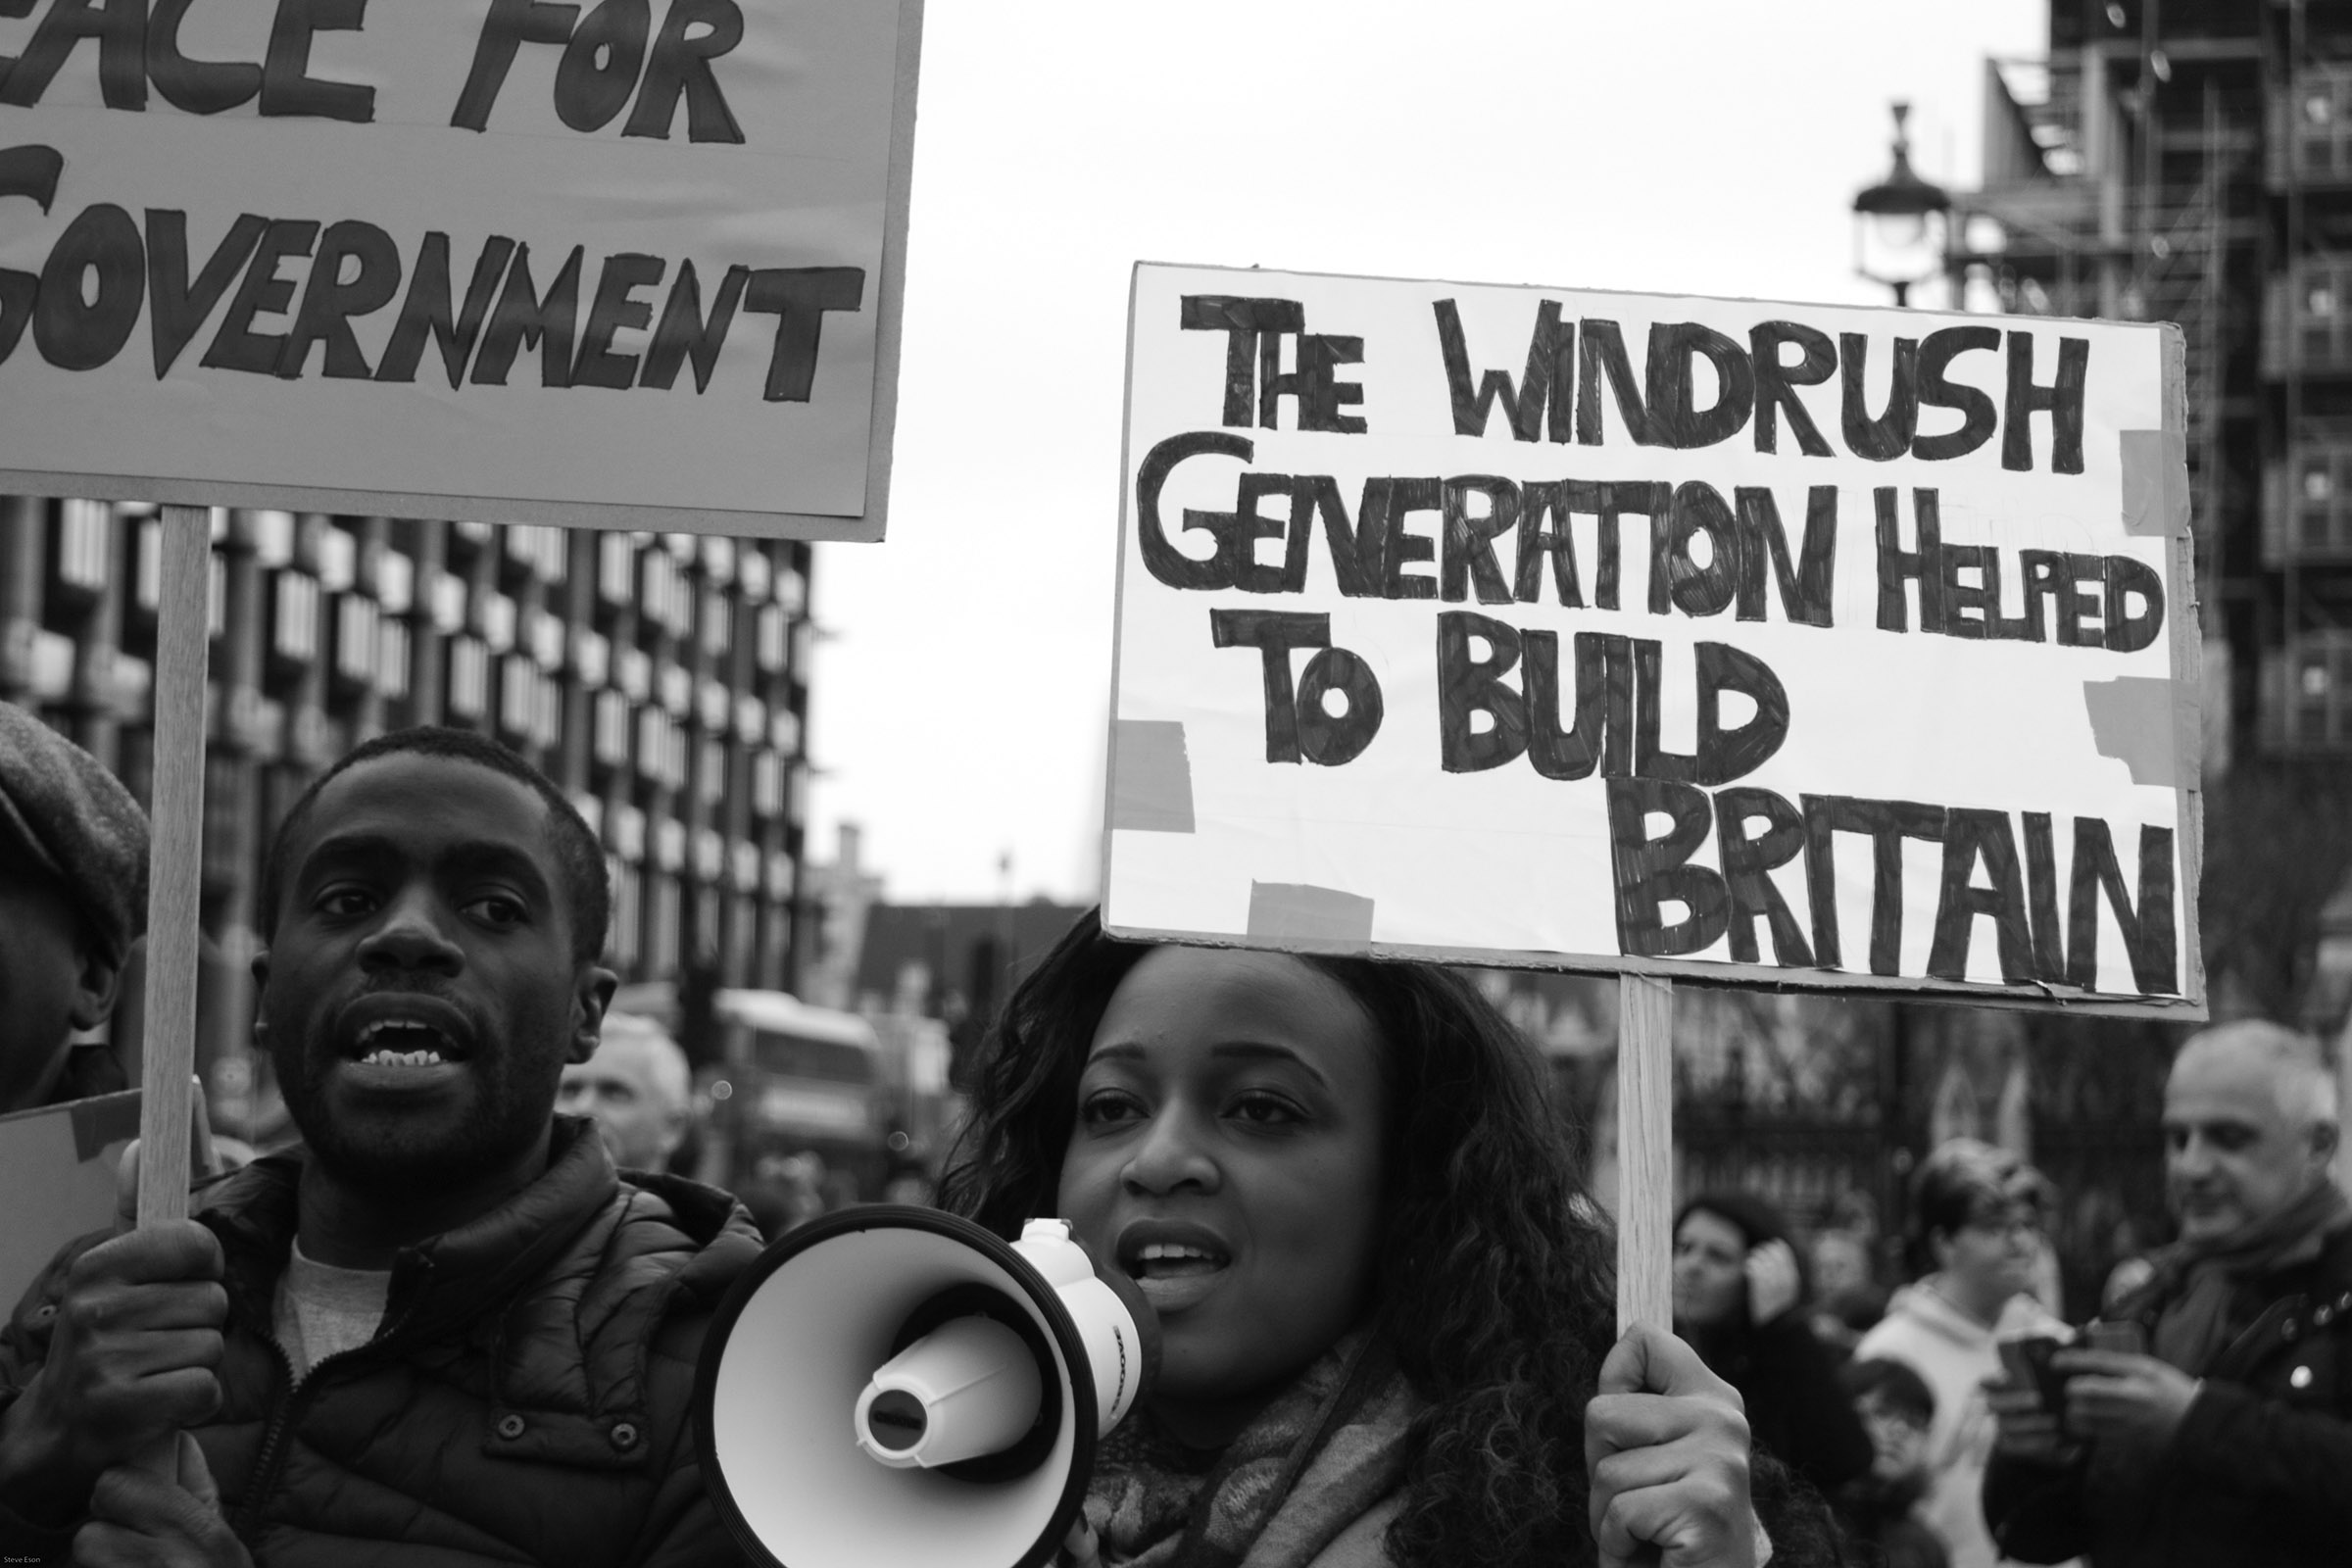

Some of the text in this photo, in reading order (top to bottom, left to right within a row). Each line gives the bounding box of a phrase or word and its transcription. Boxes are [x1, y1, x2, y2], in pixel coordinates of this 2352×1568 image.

[450, 0, 746, 144] FOR
[1181, 295, 2090, 475] THE WINDRUSH
[1136, 431, 2165, 653] GENERATION HELPED
[1210, 608, 1789, 787] TO BUILD
[1605, 777, 2180, 996] BRITAIN
